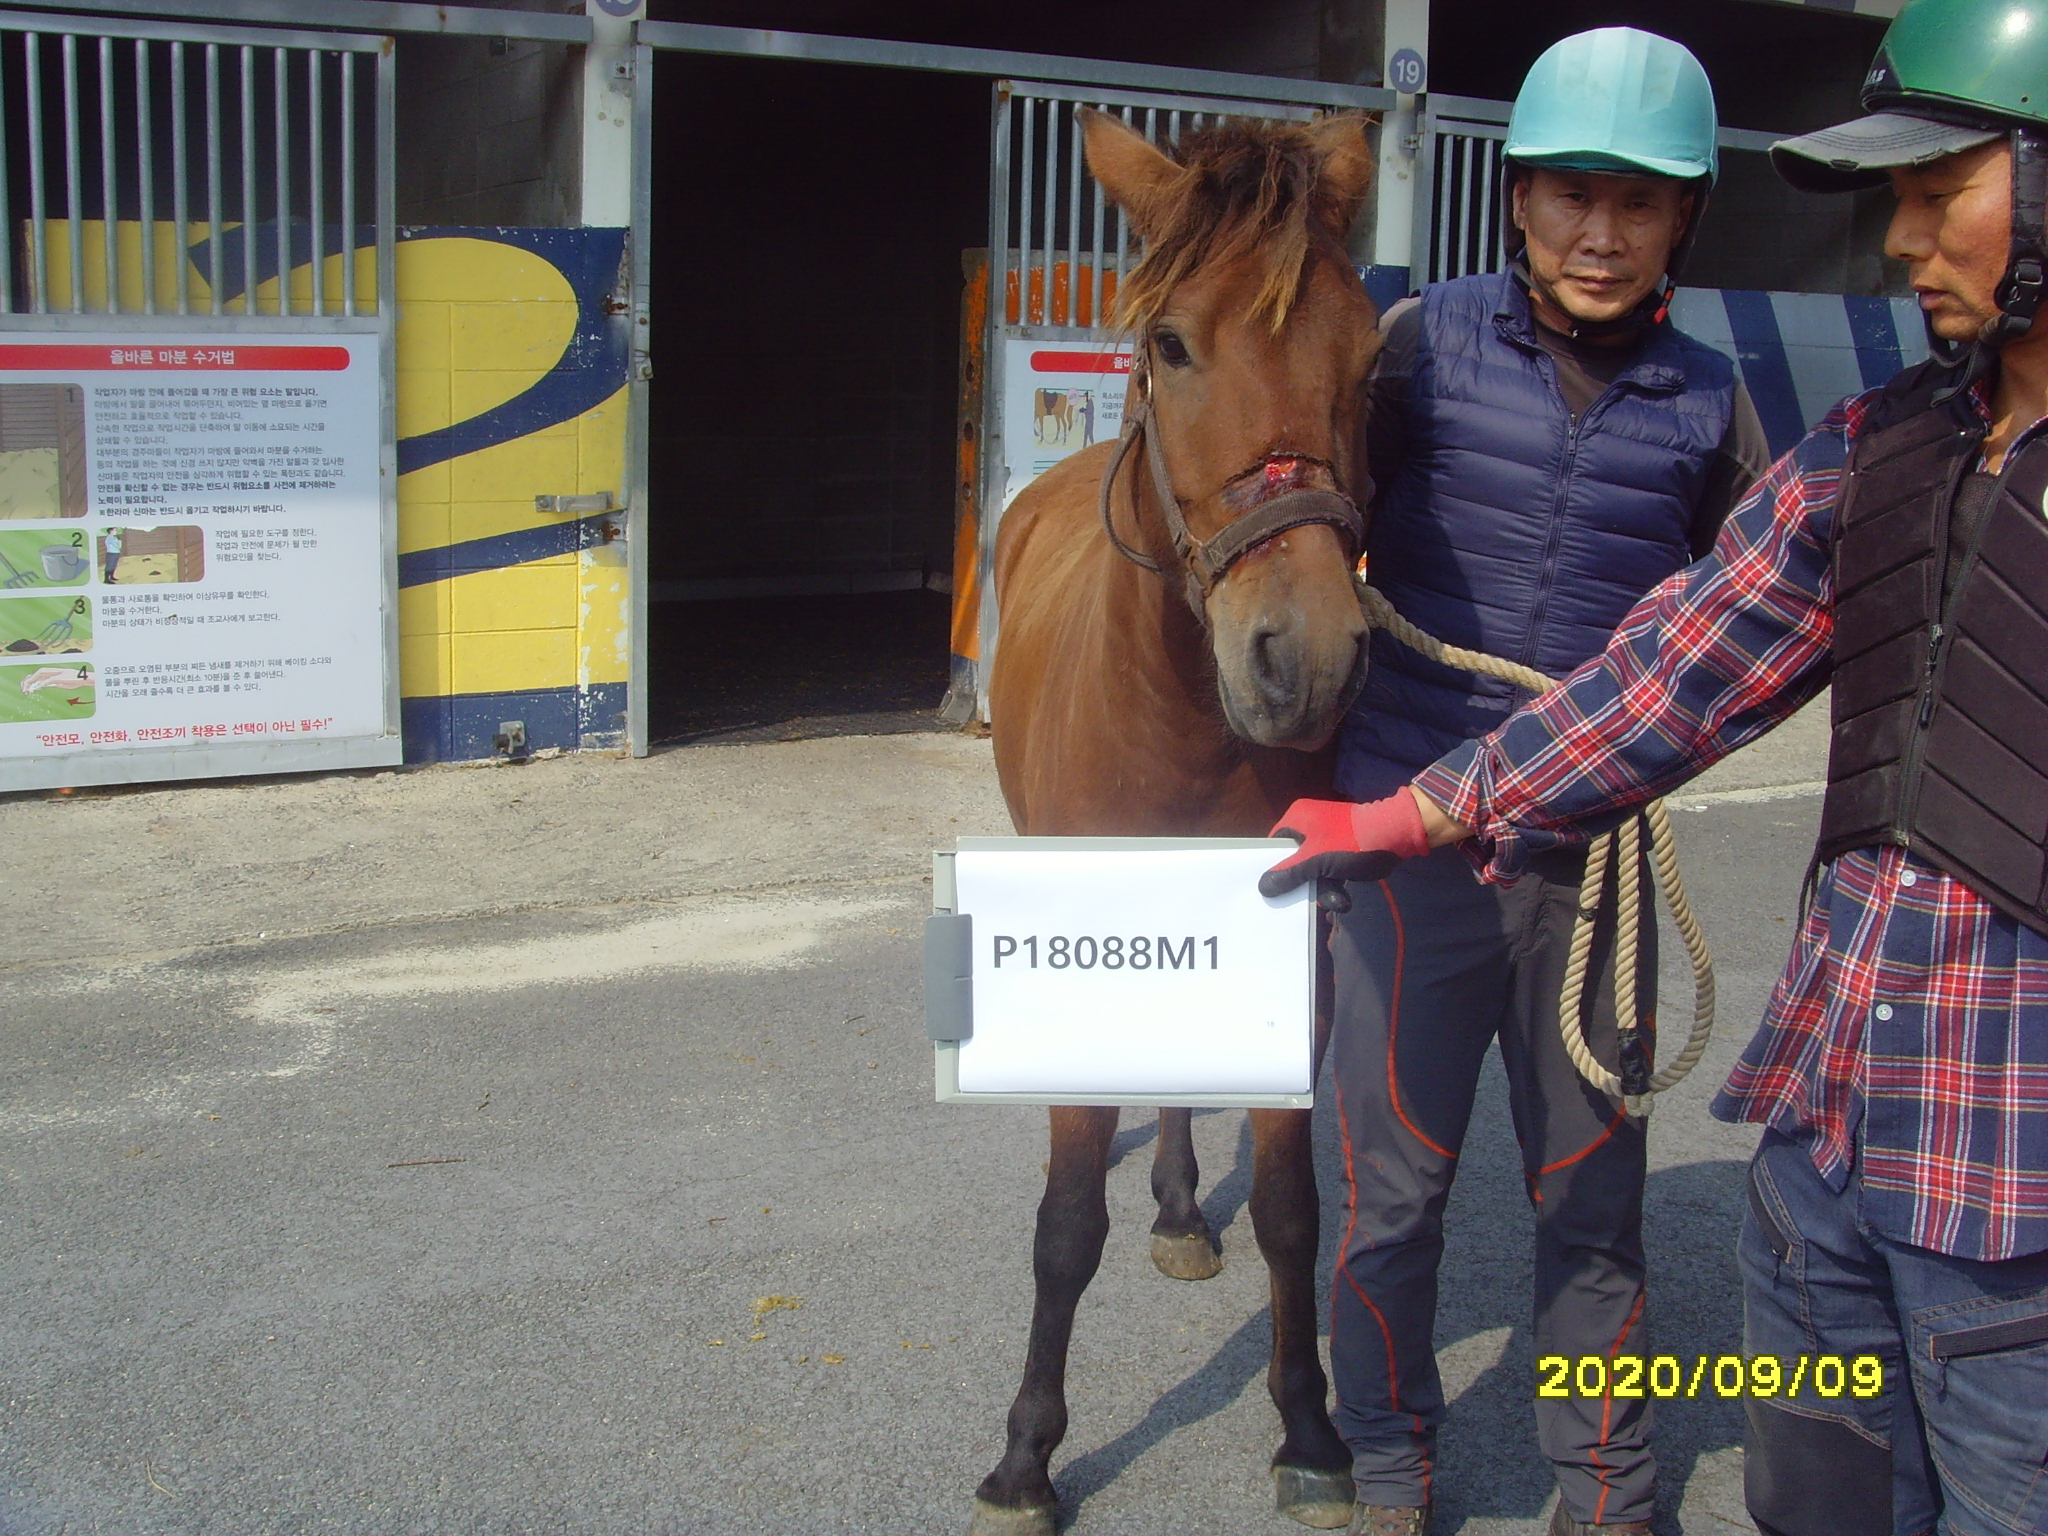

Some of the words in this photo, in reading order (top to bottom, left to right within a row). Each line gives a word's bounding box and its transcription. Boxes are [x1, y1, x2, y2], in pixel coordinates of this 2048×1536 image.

[1396, 59, 1420, 84] 19
[110, 349, 154, 365] 올바른
[159, 350, 188, 365] 마분
[193, 350, 235, 365] 수거법
[66, 388, 74, 402] 1
[260, 388, 282, 396] 요소는
[207, 482, 229, 491] 반드시
[160, 506, 183, 515] 반드시
[212, 505, 250, 514] 작업하시기
[72, 533, 82, 547] 2
[74, 600, 85, 614] 3
[129, 617, 152, 626] 상태가
[77, 666, 88, 680] 4
[89, 730, 132, 744] 안전화,
[137, 727, 186, 742] 안전조끼
[191, 724, 227, 738] 착용은
[232, 721, 268, 734] 선택이
[272, 720, 295, 732] 아닌
[994, 935, 1218, 970] P18088M1
